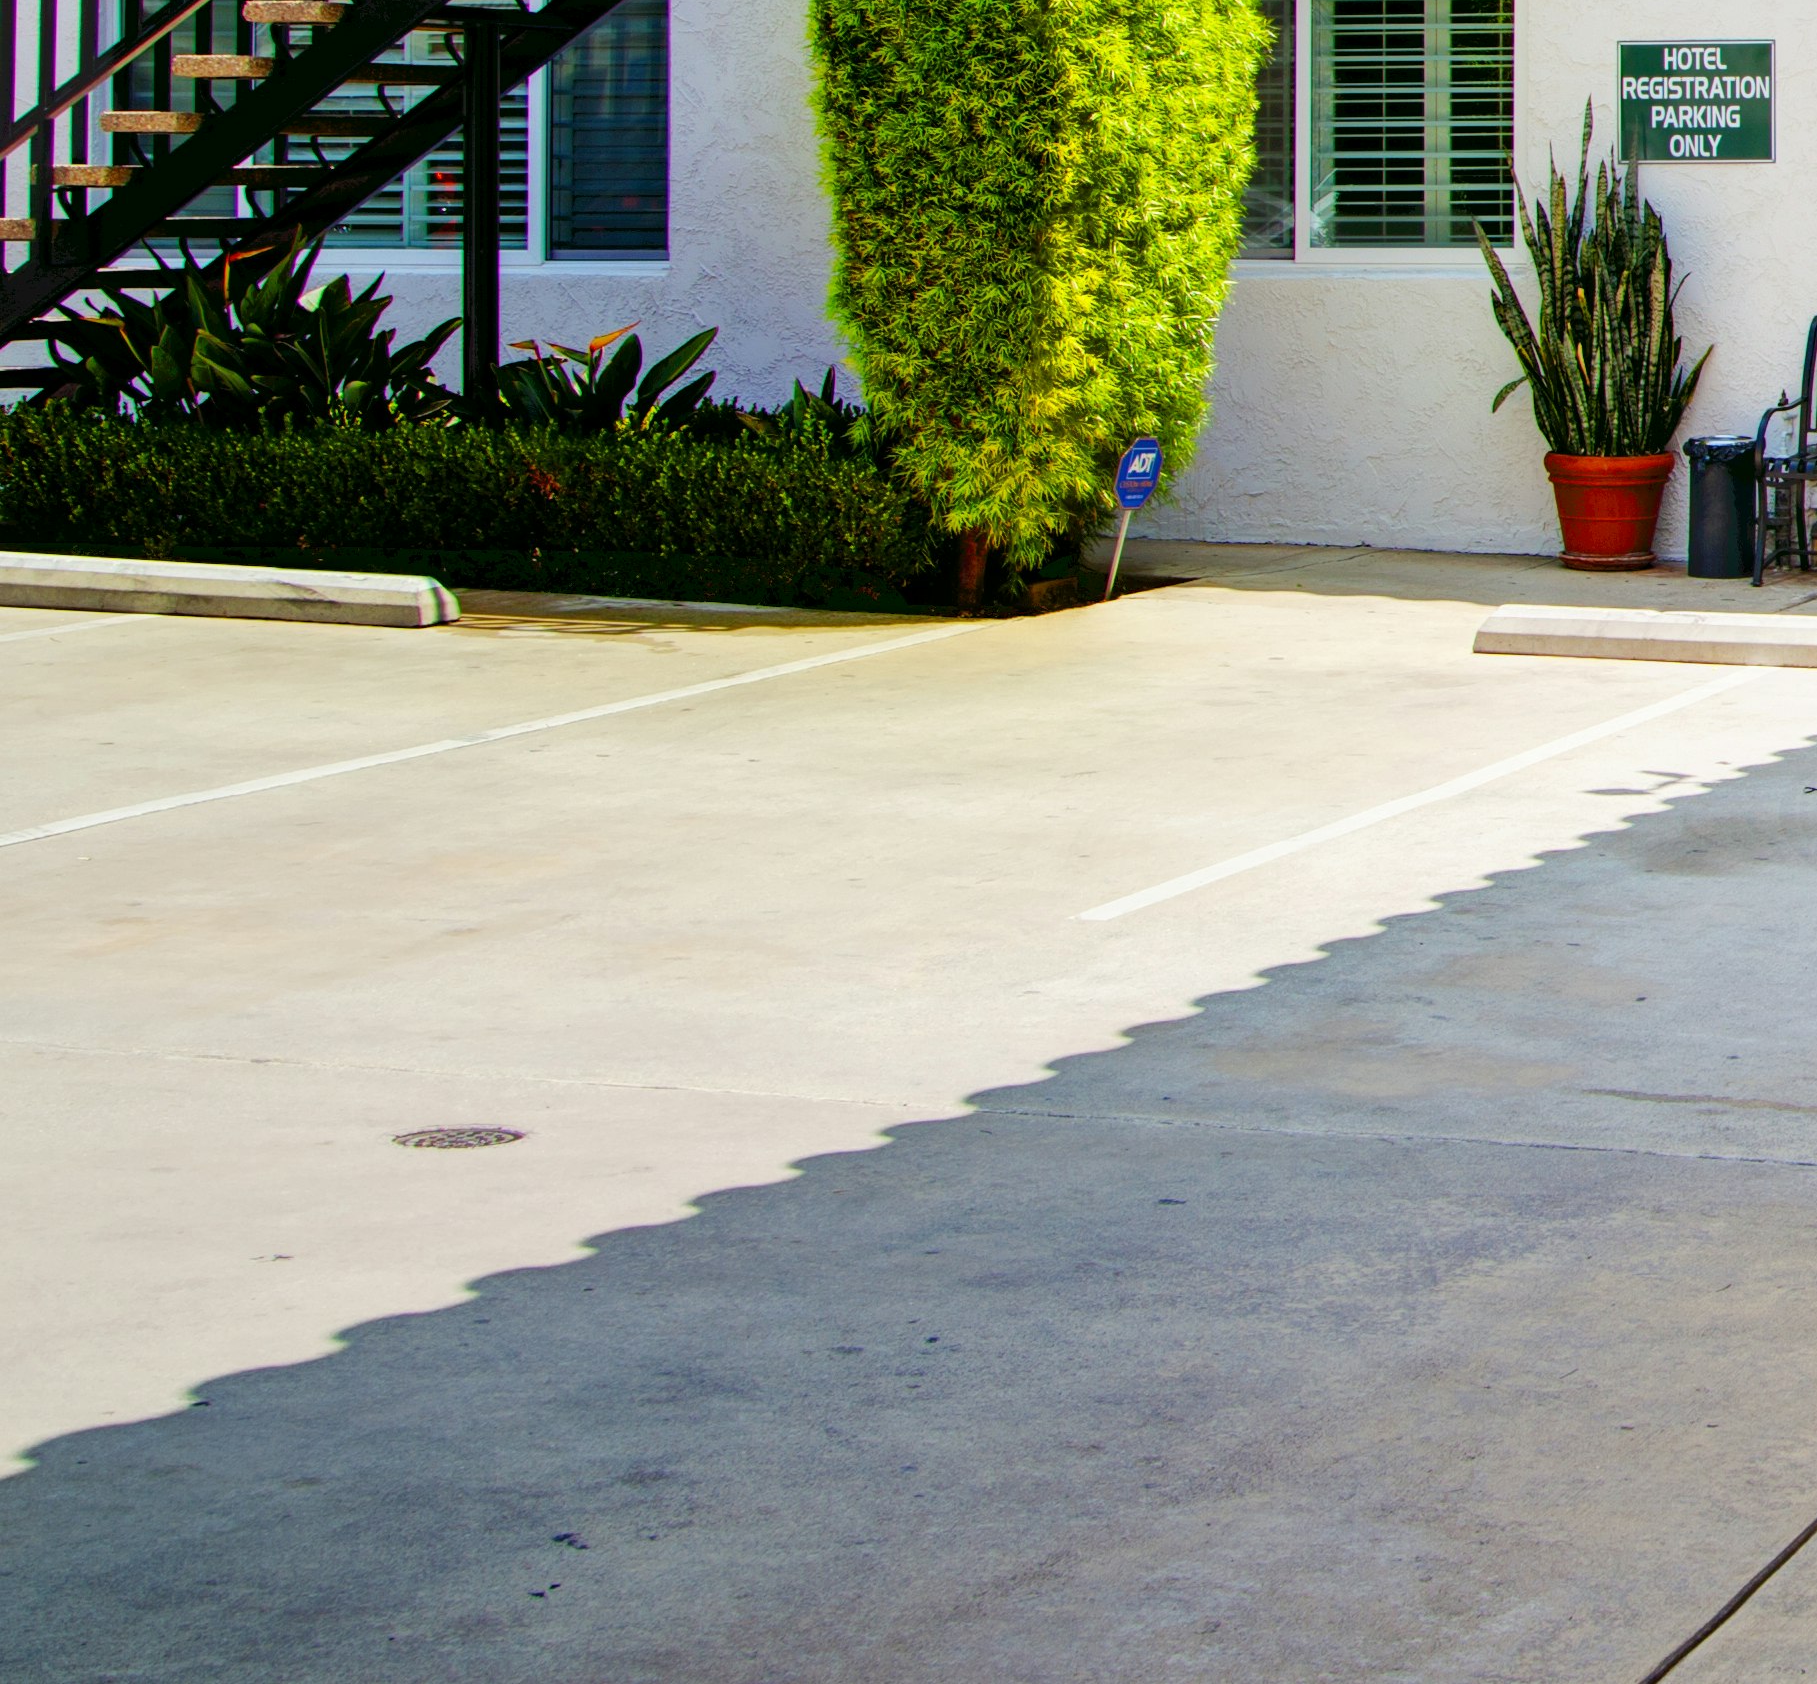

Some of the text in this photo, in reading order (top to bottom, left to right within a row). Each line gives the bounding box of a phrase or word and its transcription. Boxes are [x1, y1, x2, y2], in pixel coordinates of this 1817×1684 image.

[1663, 47, 1728, 71] HOTEL
[1622, 76, 1770, 100] REGISTRATION
[1651, 105, 1741, 129] PARKING
[1669, 134, 1722, 158] ONLY
[1128, 452, 1156, 474] ADT
